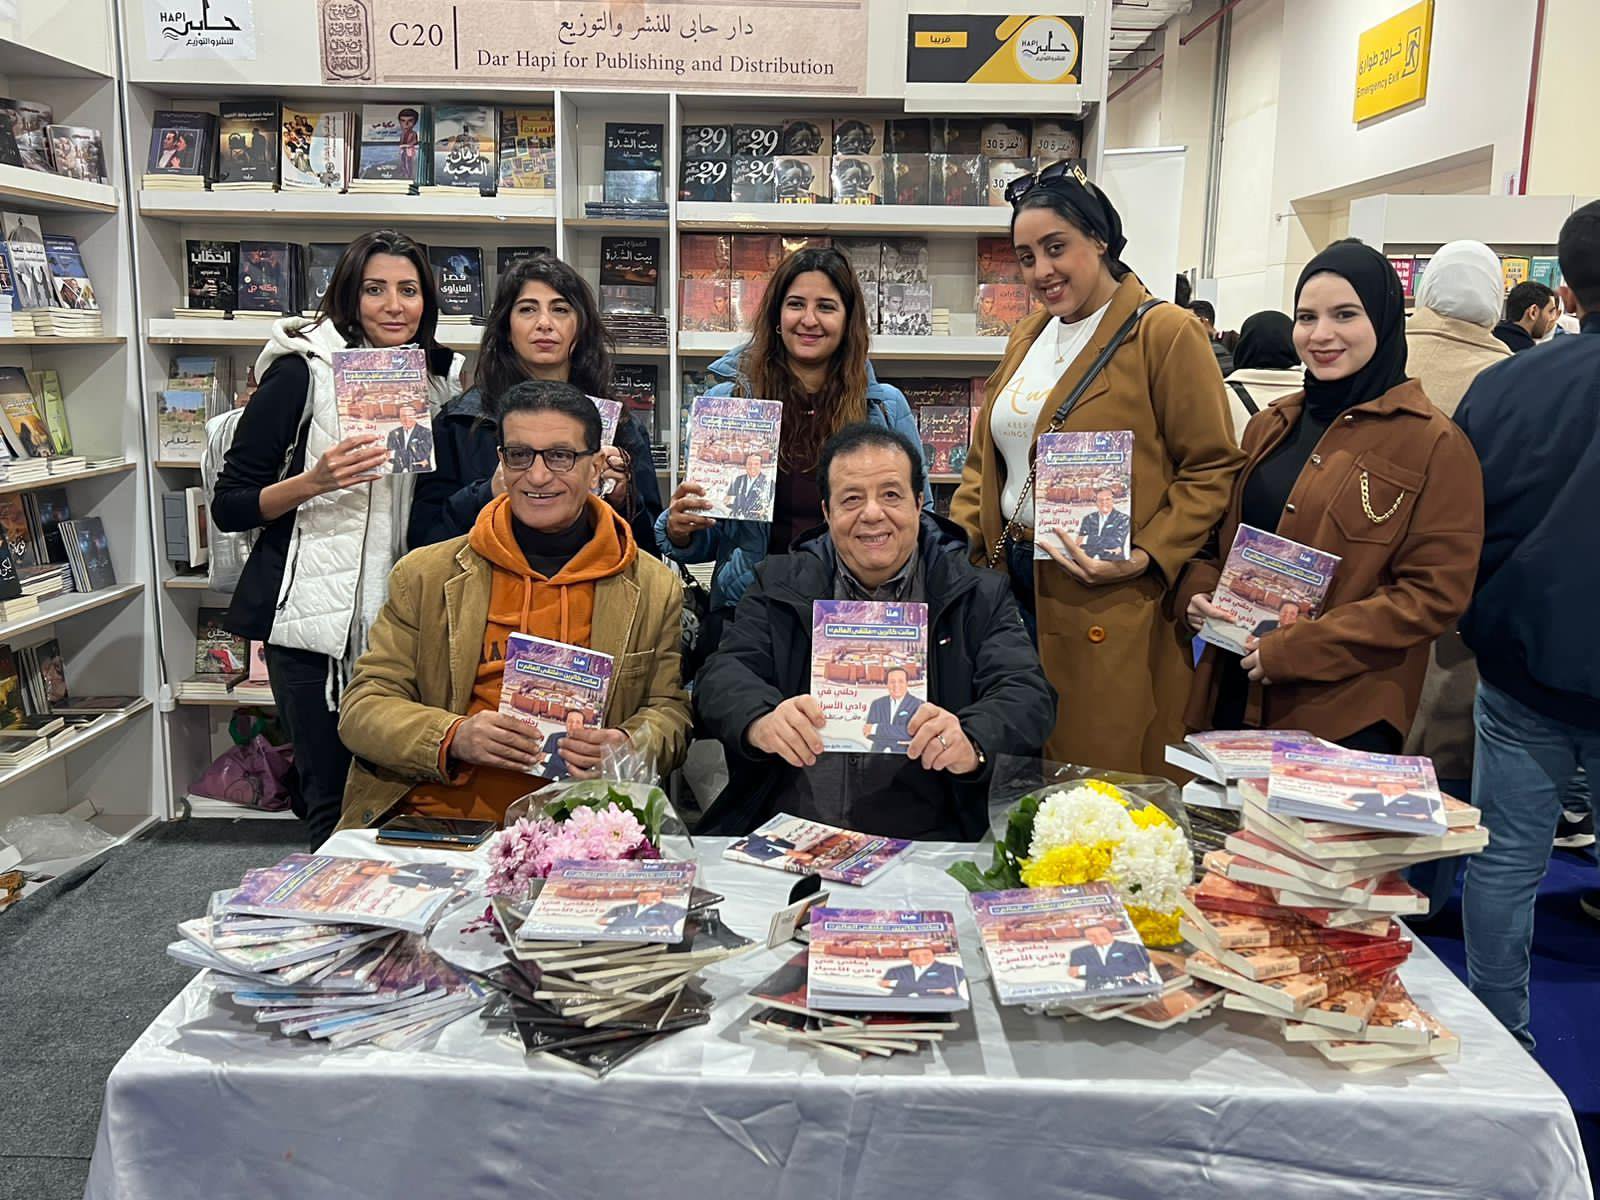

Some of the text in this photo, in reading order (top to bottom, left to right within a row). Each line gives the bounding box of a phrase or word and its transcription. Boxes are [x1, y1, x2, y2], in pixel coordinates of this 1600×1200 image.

[160, 12, 186, 22] HAPI
[389, 23, 443, 47] C20
[558, 11, 623, 45] والتوزيع
[631, 14, 671, 40] للنشر
[725, 16, 754, 40] دار
[1379, 41, 1402, 66] خروج
[477, 50, 834, 75] Dar Hapi for Publishing and Distribution
[1356, 71, 1400, 98] Emergency Exit
[638, 141, 657, 152] بيت
[699, 127, 727, 153] 29
[749, 129, 779, 157] 29
[986, 139, 998, 149] 30
[1038, 140, 1049, 150] 30
[446, 146, 480, 163] برهان
[443, 159, 488, 180] المحبة
[697, 161, 727, 185] 29
[748, 160, 776, 185] 29
[993, 179, 1005, 188] 30
[633, 253, 653, 265] بيت
[632, 379, 651, 391] بيت
[1300, 552, 1312, 563] هنا
[886, 609, 899, 617] هنا
[574, 657, 586, 666] هنا
[817, 688, 858, 697] رحلتي في
[844, 702, 867, 712] وادي
